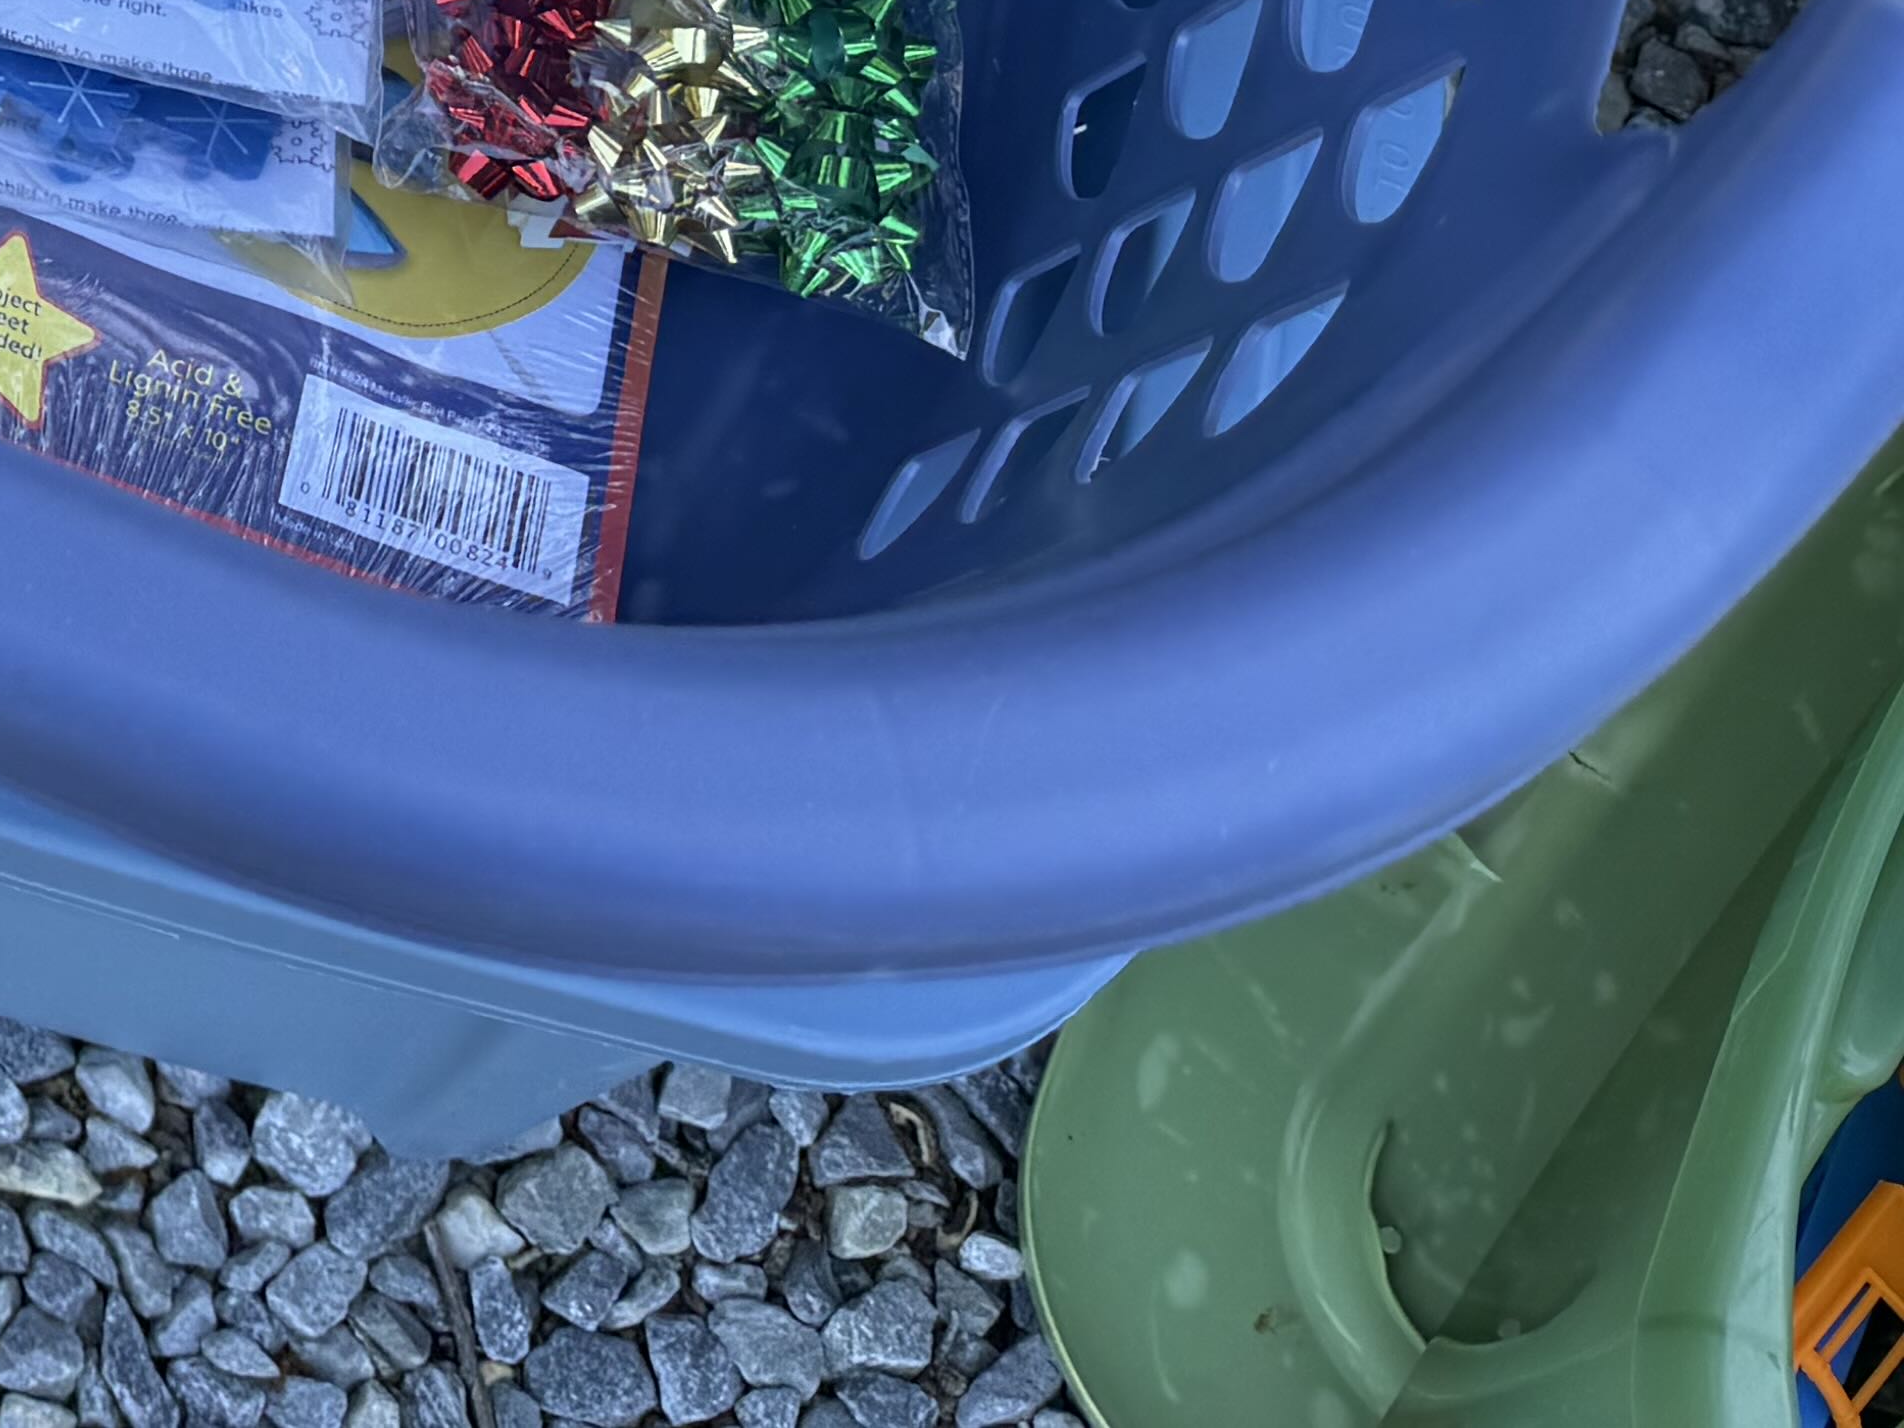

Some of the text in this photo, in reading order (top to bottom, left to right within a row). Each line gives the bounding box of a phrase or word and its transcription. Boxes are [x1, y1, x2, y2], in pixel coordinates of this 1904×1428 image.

[108, 359, 204, 410] Lignin
[208, 398, 274, 436] Free
[146, 347, 245, 400] Acid &
[300, 481, 312, 496] 0
[343, 500, 422, 538] 81187
[433, 532, 510, 571] 00824
[542, 567, 553, 581] 9
